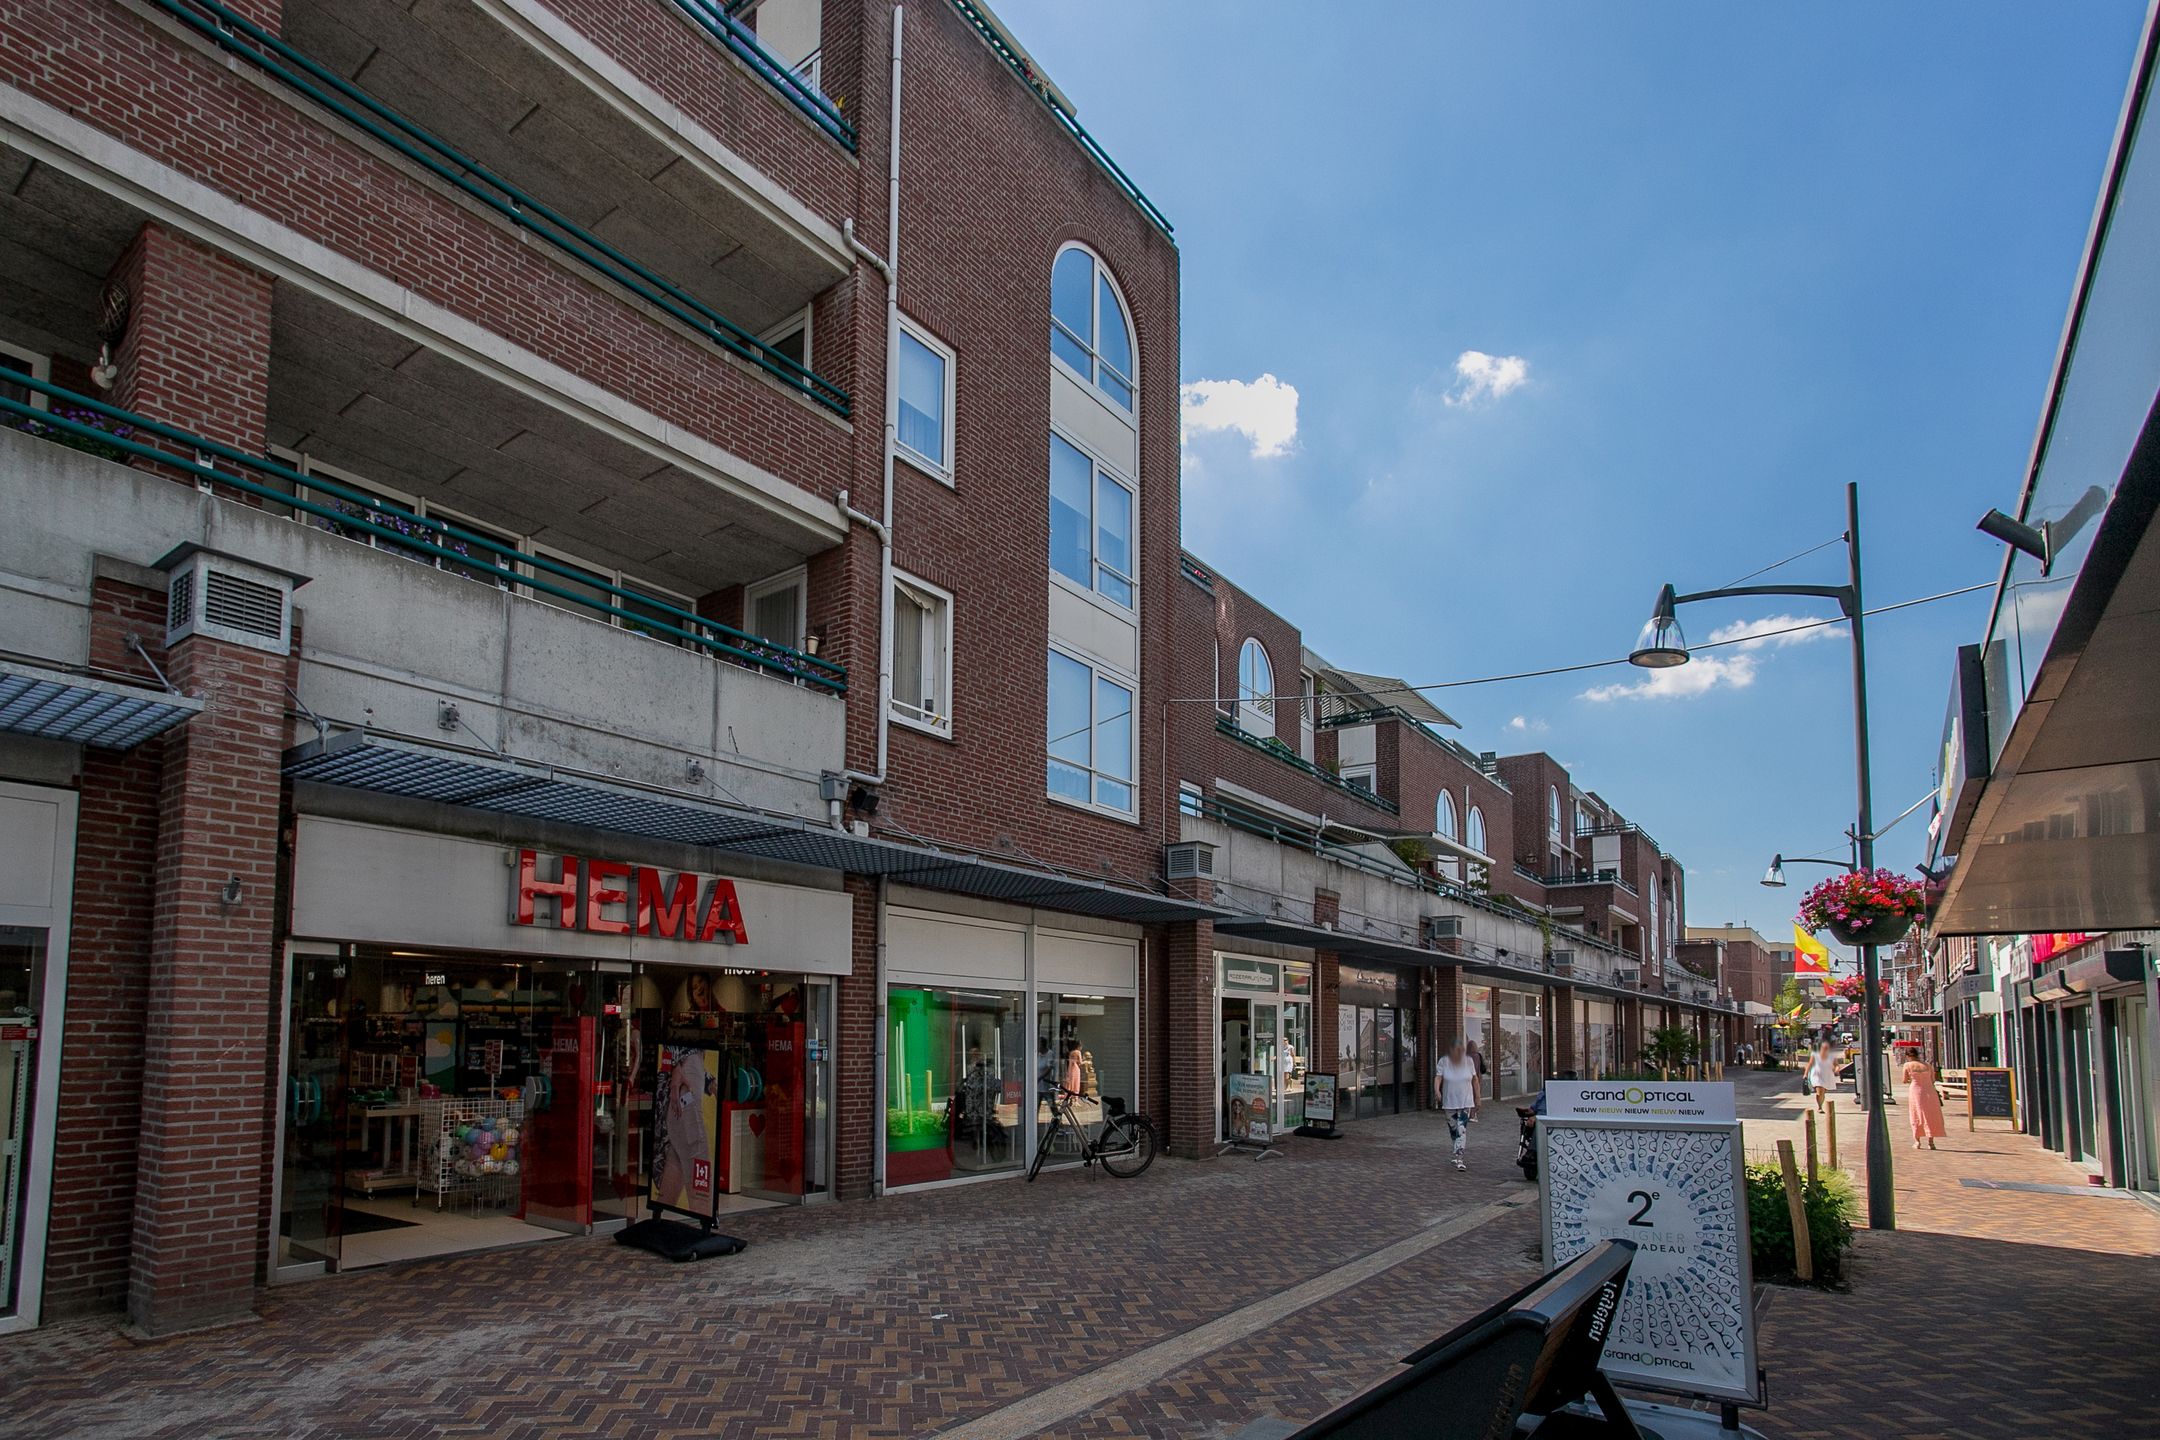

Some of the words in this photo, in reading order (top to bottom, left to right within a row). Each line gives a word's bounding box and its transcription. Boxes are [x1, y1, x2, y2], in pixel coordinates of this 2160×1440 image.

[519, 848, 749, 945] HEMA
[425, 973, 445, 985] heren
[553, 1038, 579, 1052] HEMA
[768, 1039, 793, 1052] HEMA
[695, 1163, 709, 1180] 1+1
[694, 1178, 708, 1188] gratis
[1600, 1226, 1685, 1243] DESIGNER
[1638, 1243, 1685, 1254] ADEAU
